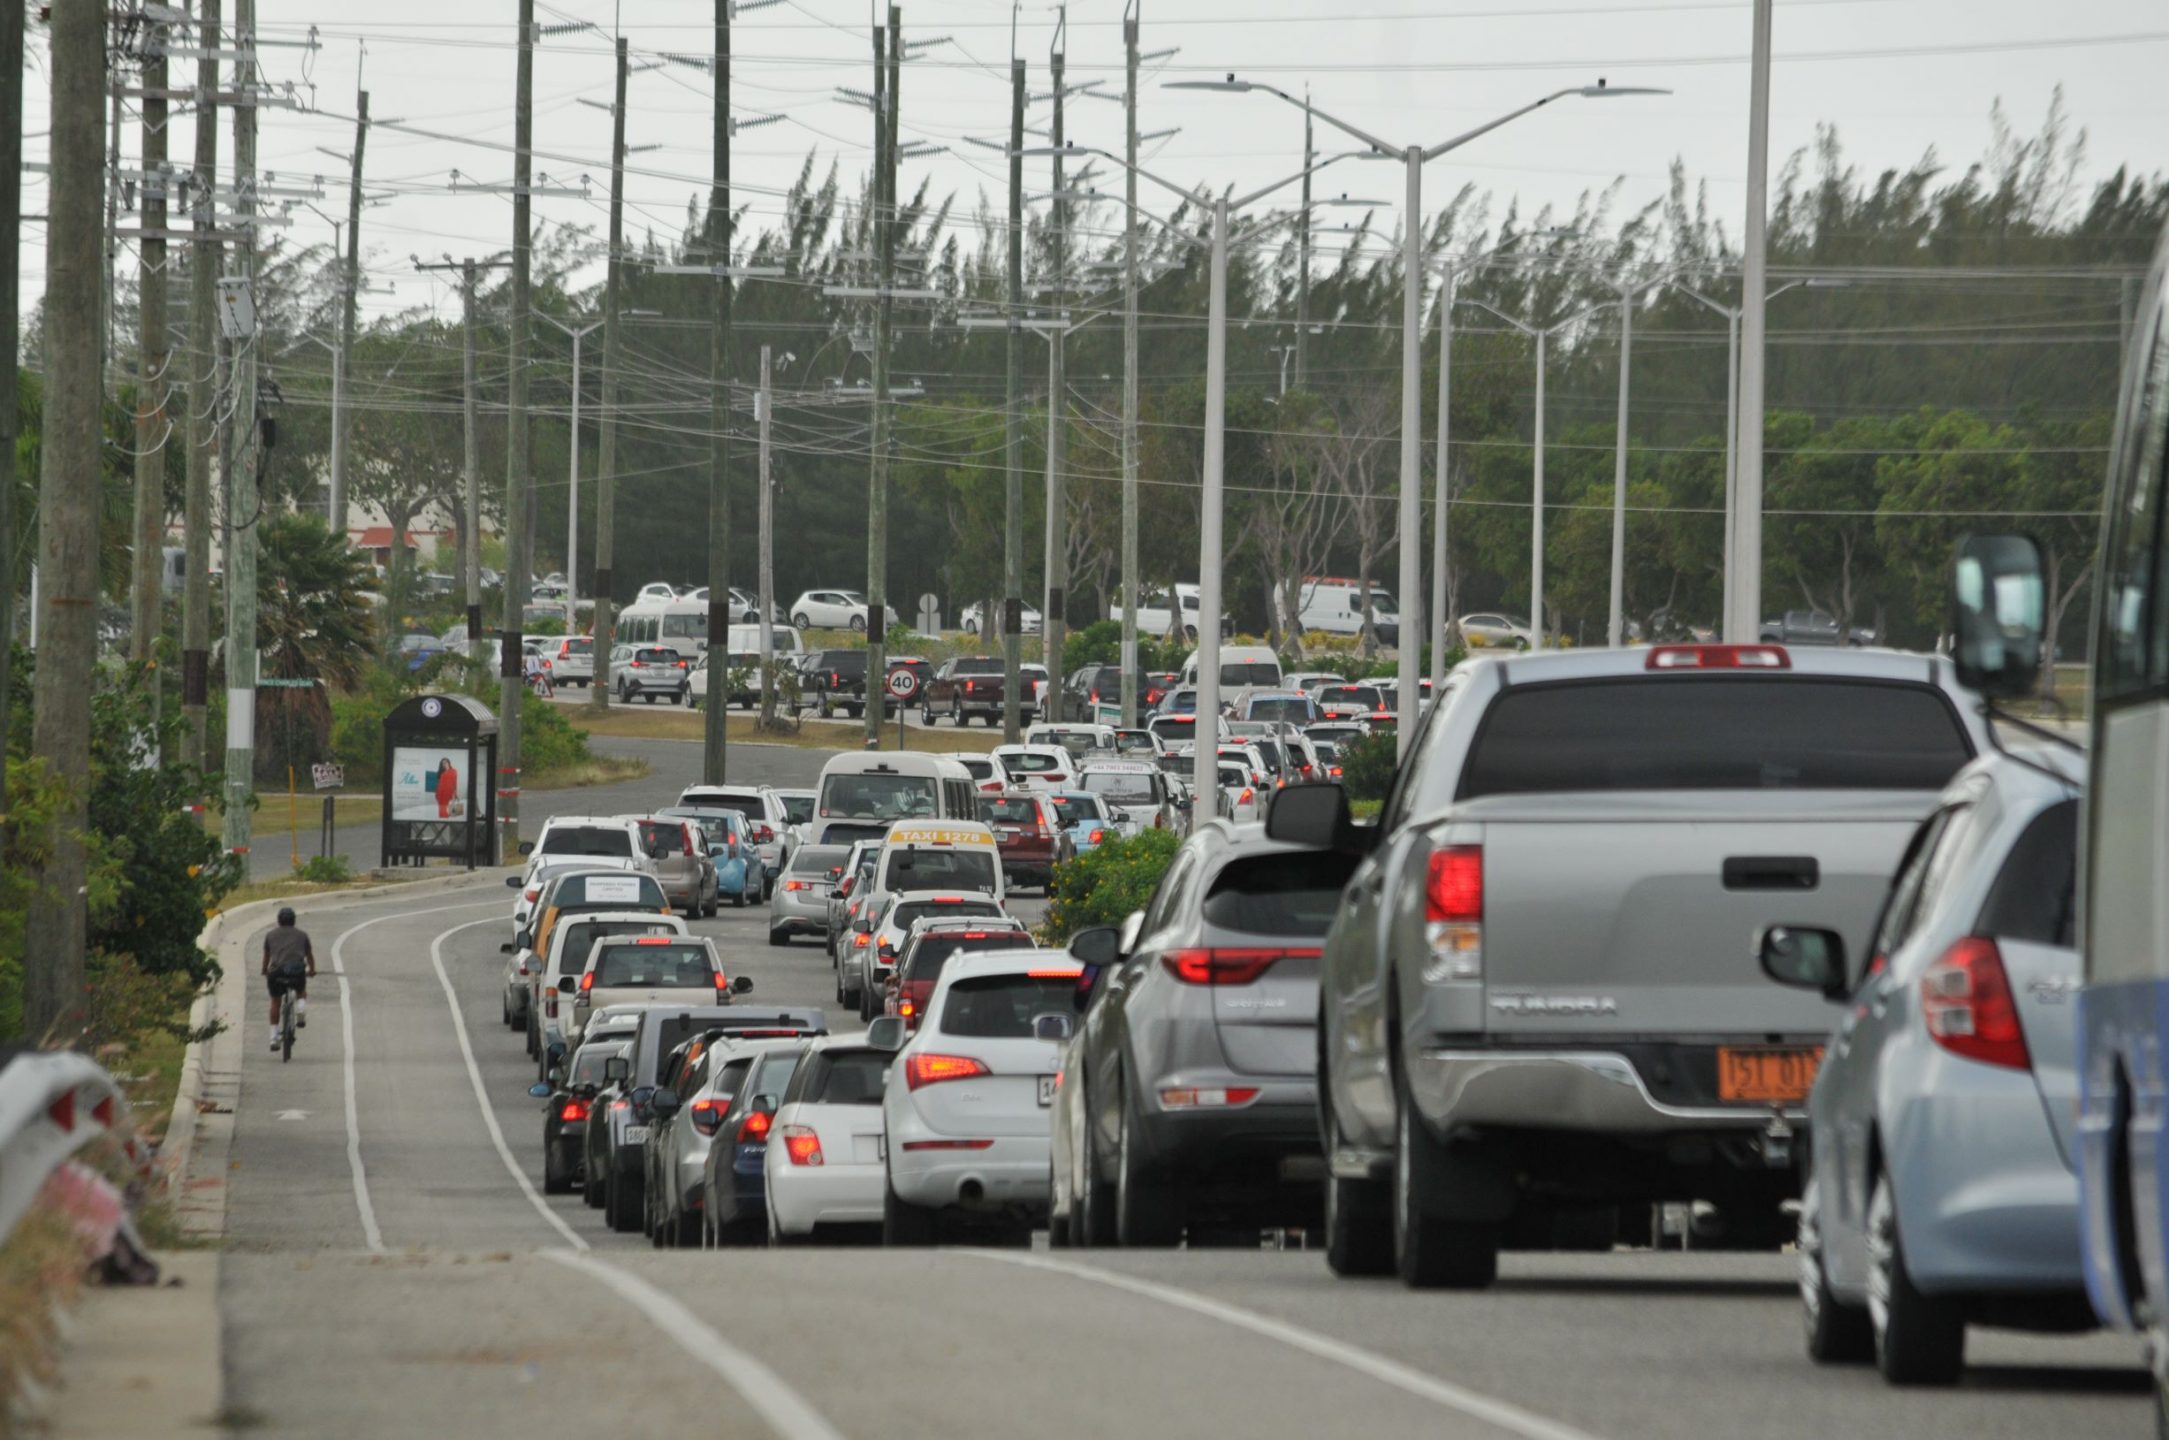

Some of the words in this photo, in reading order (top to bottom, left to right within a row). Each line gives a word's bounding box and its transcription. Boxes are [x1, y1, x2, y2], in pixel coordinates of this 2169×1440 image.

[892, 676, 913, 689] 40
[902, 831, 937, 840] TAXI
[942, 832, 980, 842] 1278
[1489, 996, 1617, 1014] TUNDRA
